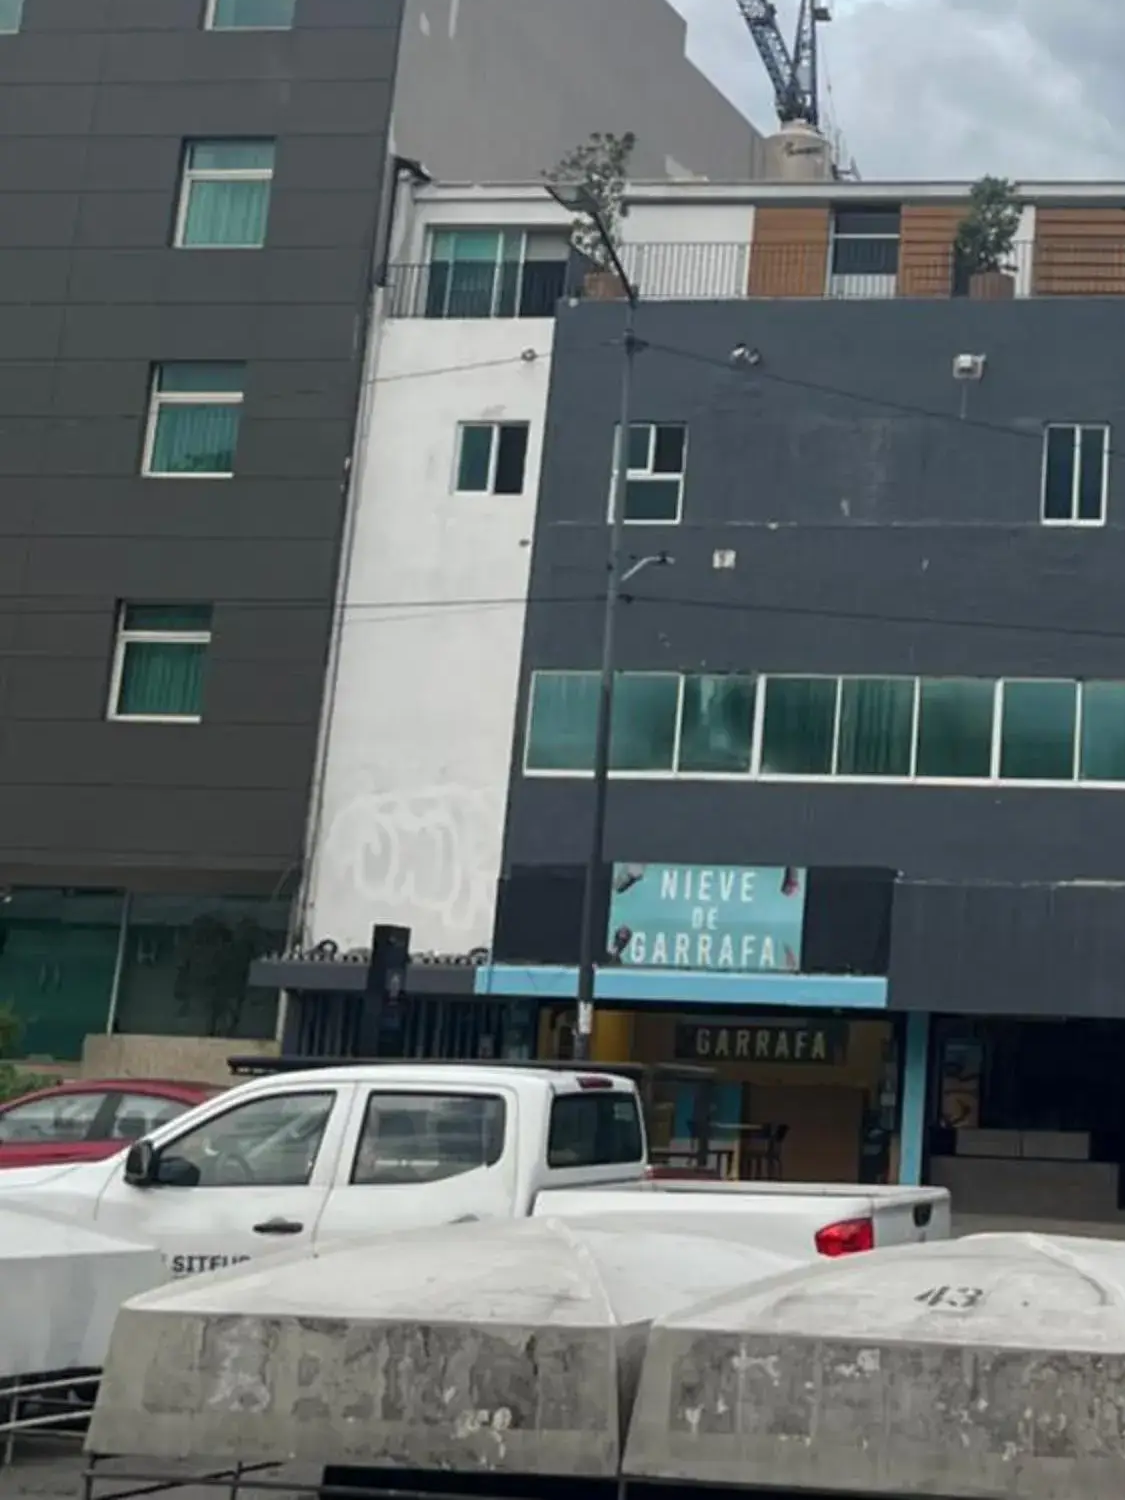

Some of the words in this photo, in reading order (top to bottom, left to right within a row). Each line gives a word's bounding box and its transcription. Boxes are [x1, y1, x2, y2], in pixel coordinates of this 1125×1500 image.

[661, 869, 758, 902] NIEVE
[692, 905, 719, 930] DE
[631, 931, 775, 968] GARRAFA
[696, 1027, 826, 1060] GARRAFA
